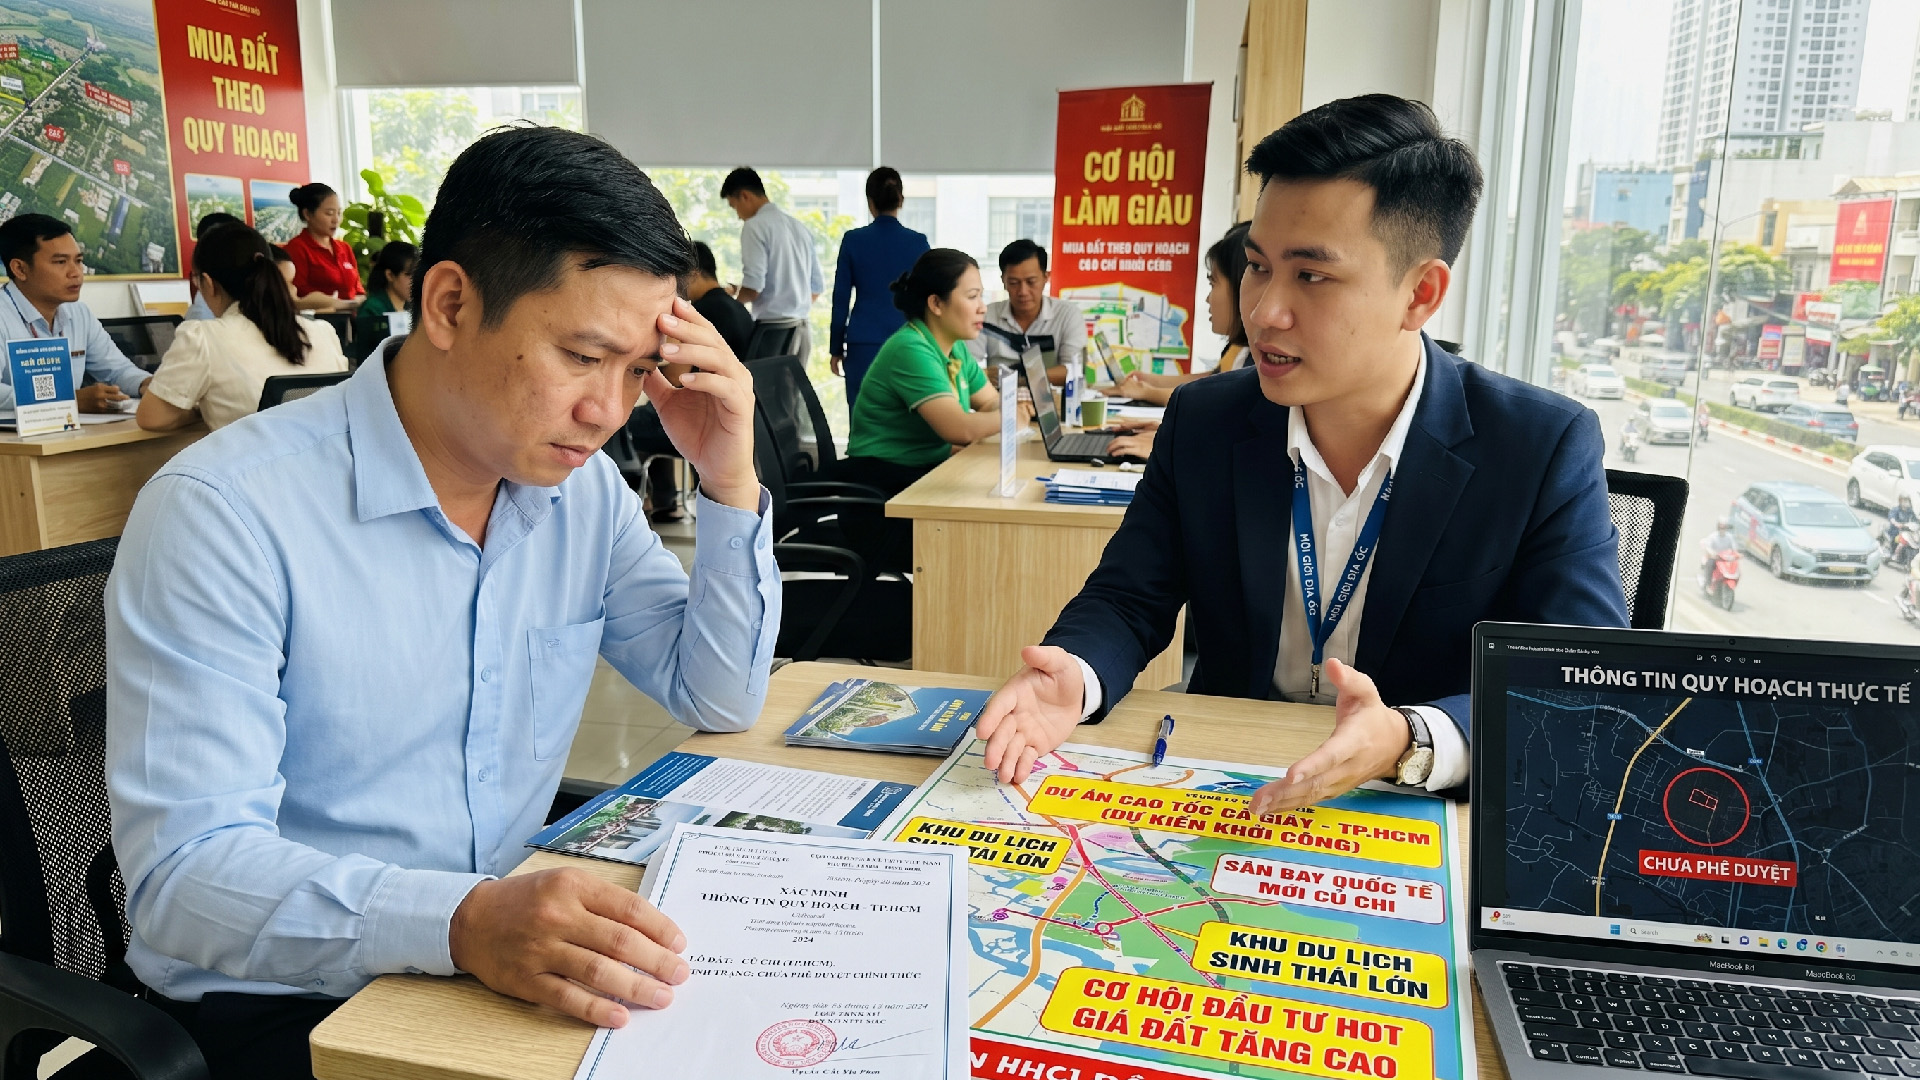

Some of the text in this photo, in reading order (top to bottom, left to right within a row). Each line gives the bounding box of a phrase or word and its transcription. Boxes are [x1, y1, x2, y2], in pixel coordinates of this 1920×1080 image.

[187, 24, 279, 76] MUA ĐẤT
[212, 75, 266, 116] THEO
[183, 117, 299, 166] QUY HOẠCH
[1083, 142, 1176, 188] CƠ HỘI
[1062, 187, 1194, 226] LÀM GIÀU
[1062, 241, 1085, 254] MUA
[1107, 241, 1132, 254] THEO
[1133, 241, 1154, 255] QUY
[1154, 241, 1190, 257] HOẠCH
[1561, 665, 1912, 706] THÔNG TIN QUY HOẠCH THỰC TẾ
[1044, 786, 1078, 800] DỰ
[1080, 788, 1111, 803] ÁN
[1118, 795, 1164, 809] CAO
[1171, 801, 1215, 816] TỐC
[1337, 822, 1431, 846] TP.HCM
[1101, 808, 1361, 854] (DỰ KIẾN KHỞI CÔNG)
[917, 822, 966, 838] KHU
[968, 829, 1001, 844] DU
[1003, 835, 1058, 852] LỊCH
[1224, 860, 1434, 900] SÂN BAY QUỐC TẾ
[1643, 855, 1791, 884] CHƯA PHÊ DUYỆT
[752, 897, 776, 906] TIN
[779, 899, 809, 909] QUY
[810, 901, 860, 912] HOẠCH
[870, 904, 921, 913] TP.HCM
[810, 889, 848, 898] MINH
[1259, 881, 1396, 913] MỚI CỦ CHI
[1229, 931, 1413, 973] KHU DU LỊCH
[1709, 960, 1743, 971] MacBook
[1209, 951, 1428, 999] SINH THÁI LỚN
[1083, 978, 1404, 1046] CƠ HỘI ĐẦU TƯ HOT
[1072, 1007, 1397, 1079] GIÁ ĐẤT TĂNG CAO
